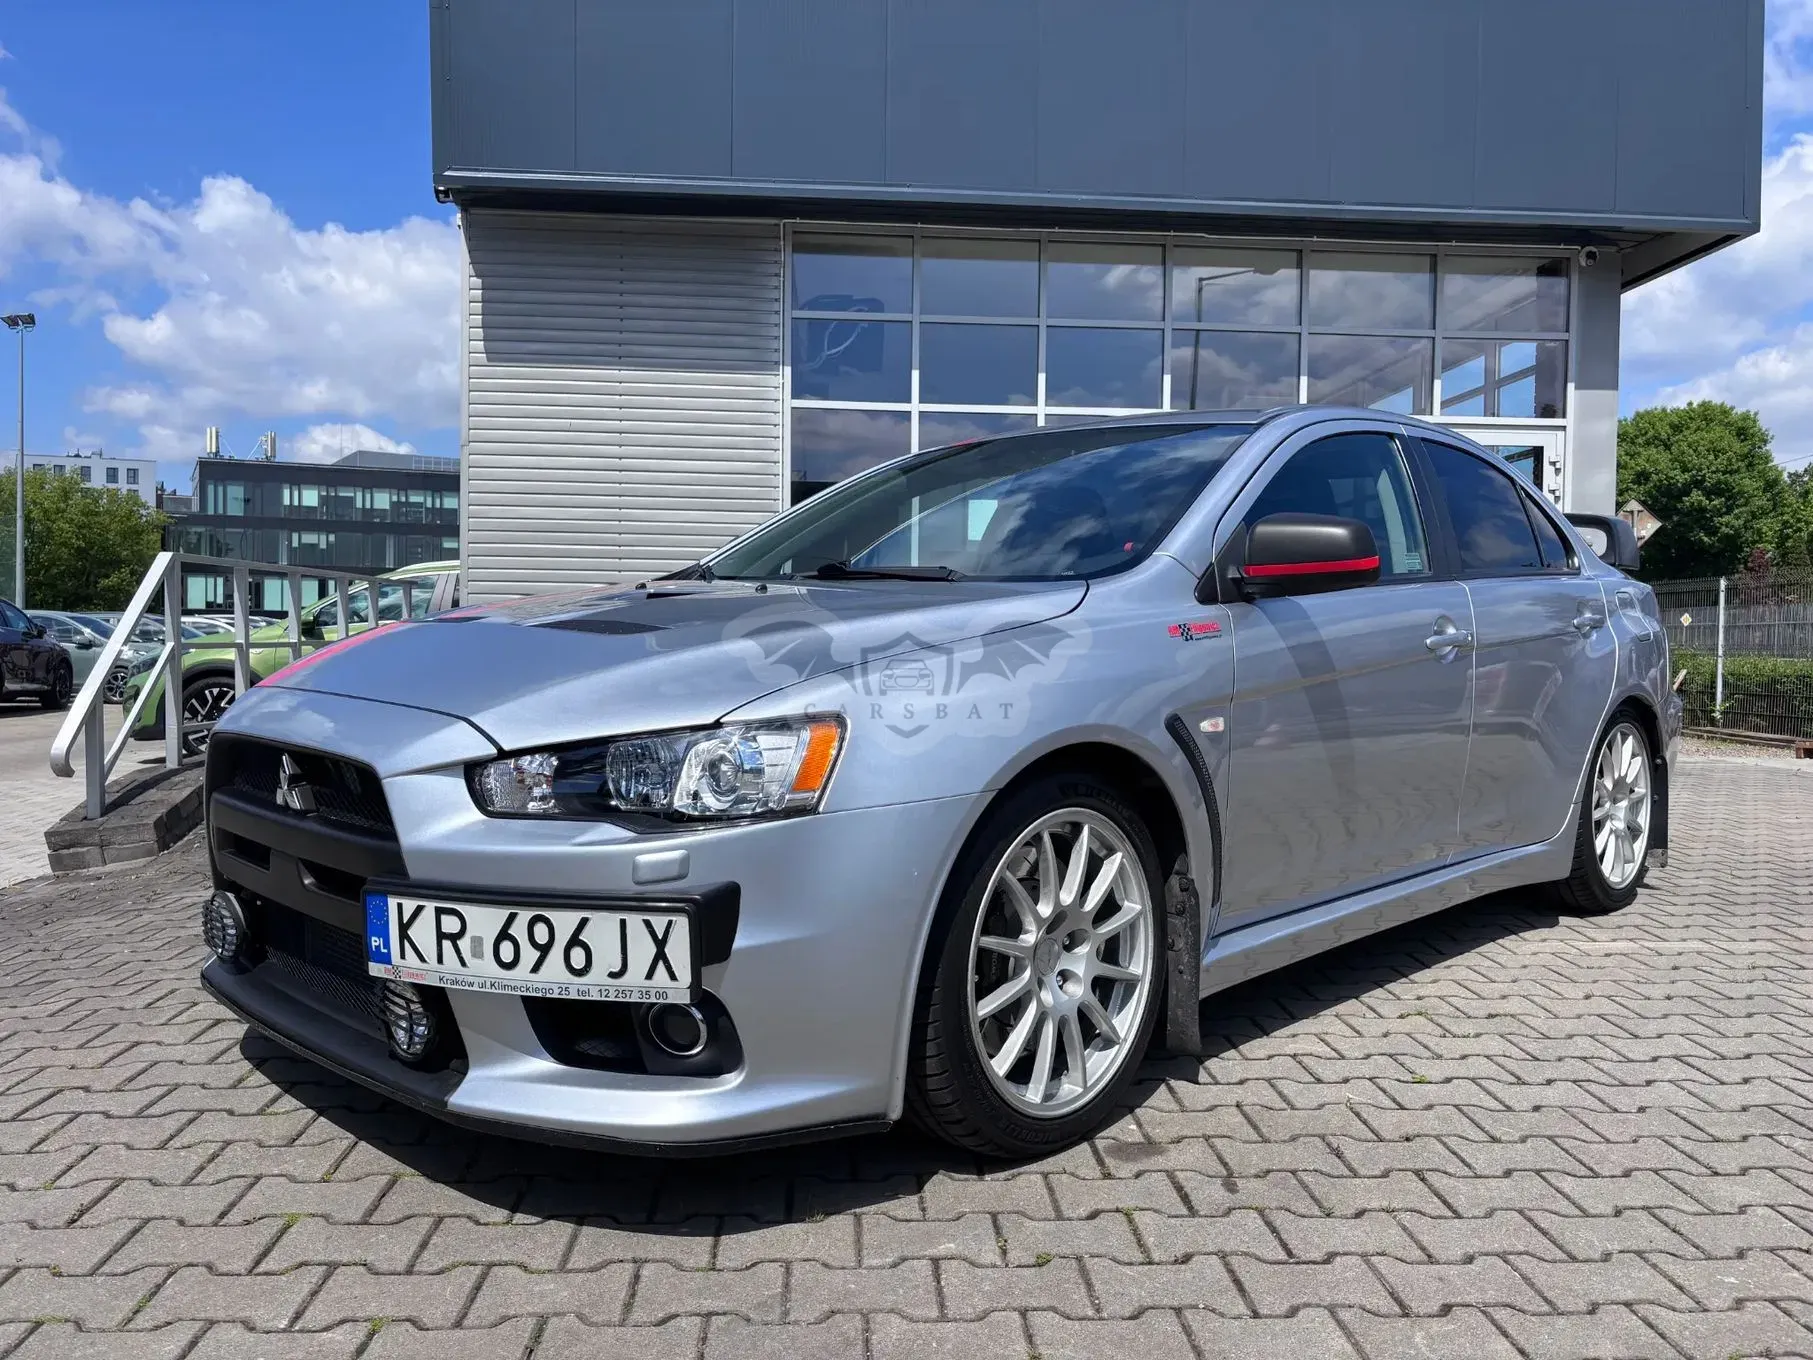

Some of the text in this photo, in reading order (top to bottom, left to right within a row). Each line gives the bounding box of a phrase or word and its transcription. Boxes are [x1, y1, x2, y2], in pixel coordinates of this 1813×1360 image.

[371, 936, 388, 953] PL
[396, 902, 680, 982] KR 696JX
[438, 975, 668, 1000] Kraków ul.Klimeckiego 25 tel. 12 257 35 00
